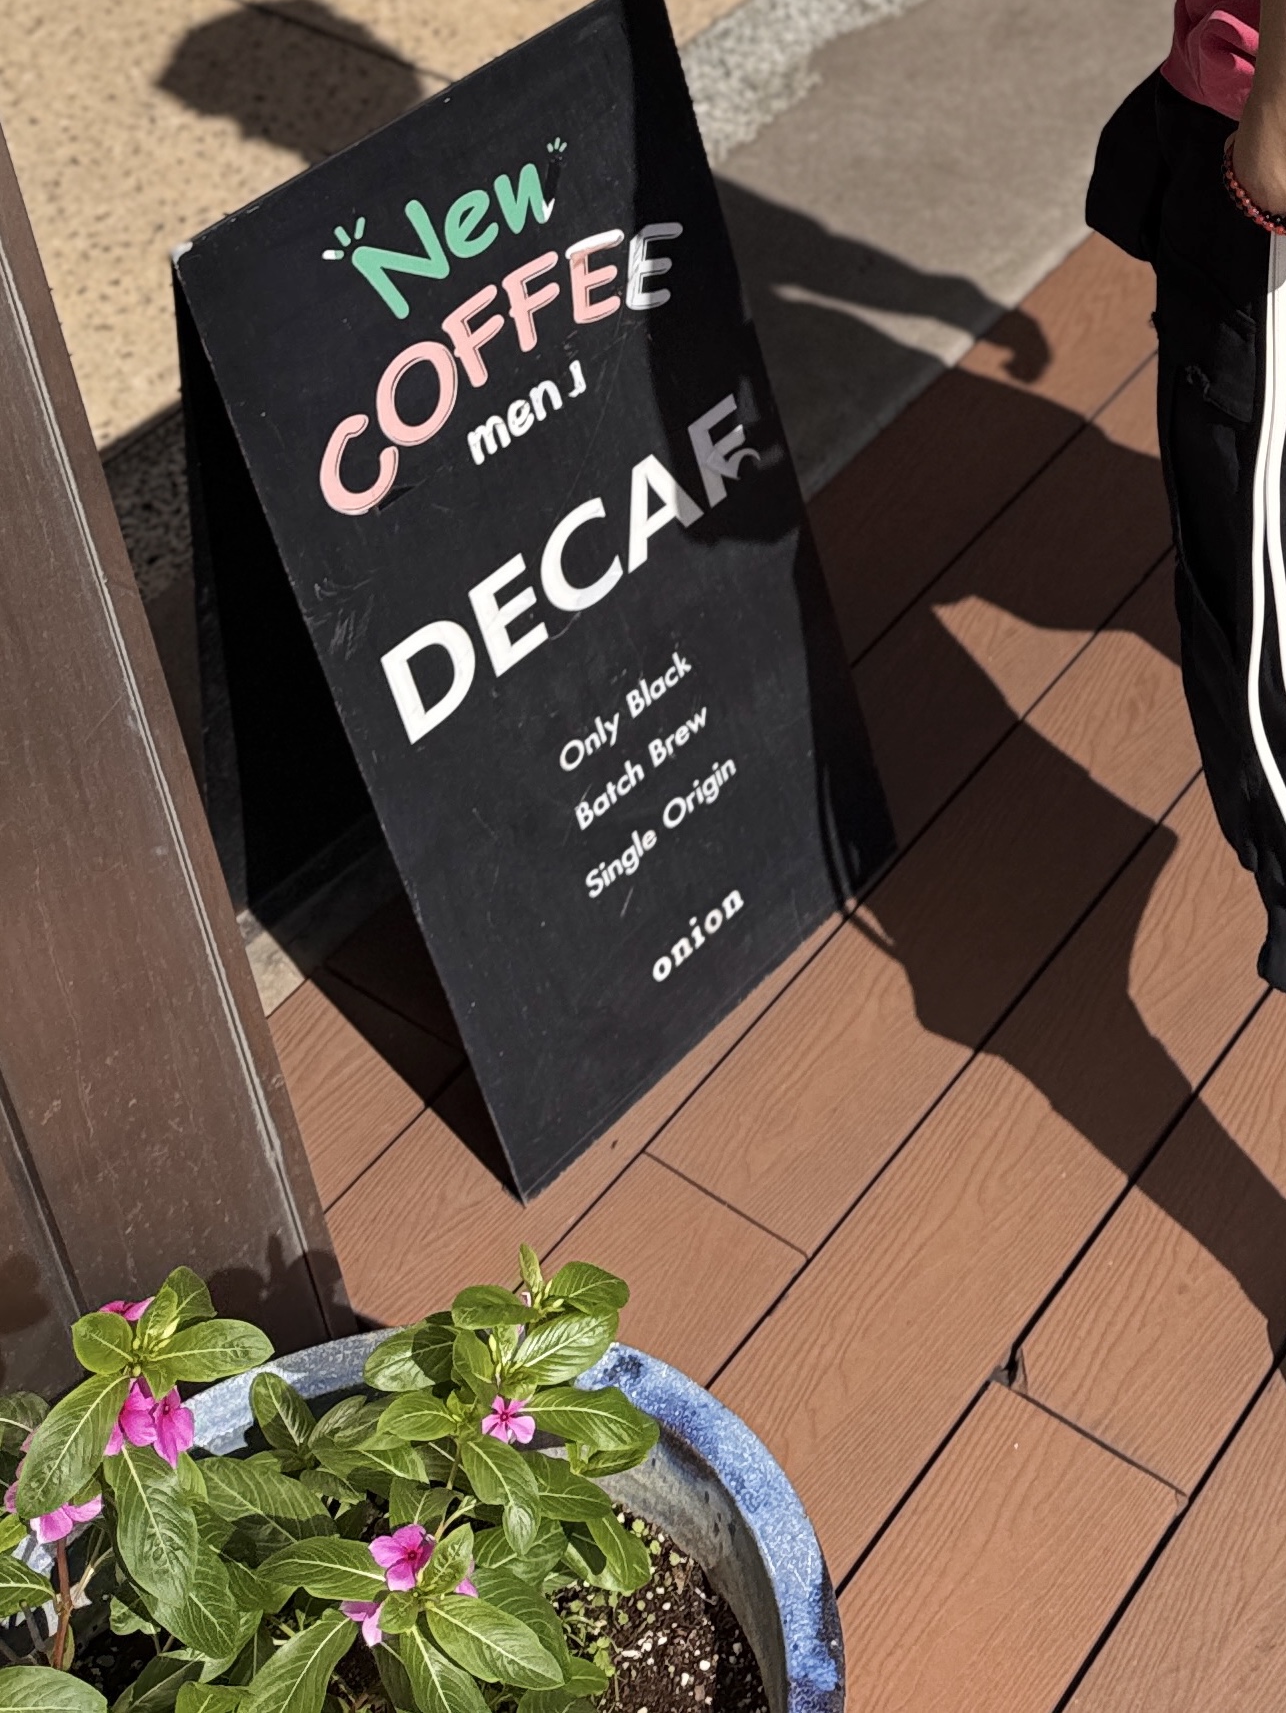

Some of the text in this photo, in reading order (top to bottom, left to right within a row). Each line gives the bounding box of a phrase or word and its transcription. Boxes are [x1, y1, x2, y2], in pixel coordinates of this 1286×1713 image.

[319, 222, 684, 516] COFFEE
[380, 393, 748, 745] DECAF
[559, 651, 692, 772] Only Black
[575, 706, 707, 831] Batch Brew
[585, 758, 737, 899] Single Origin
[651, 889, 745, 982] onion
